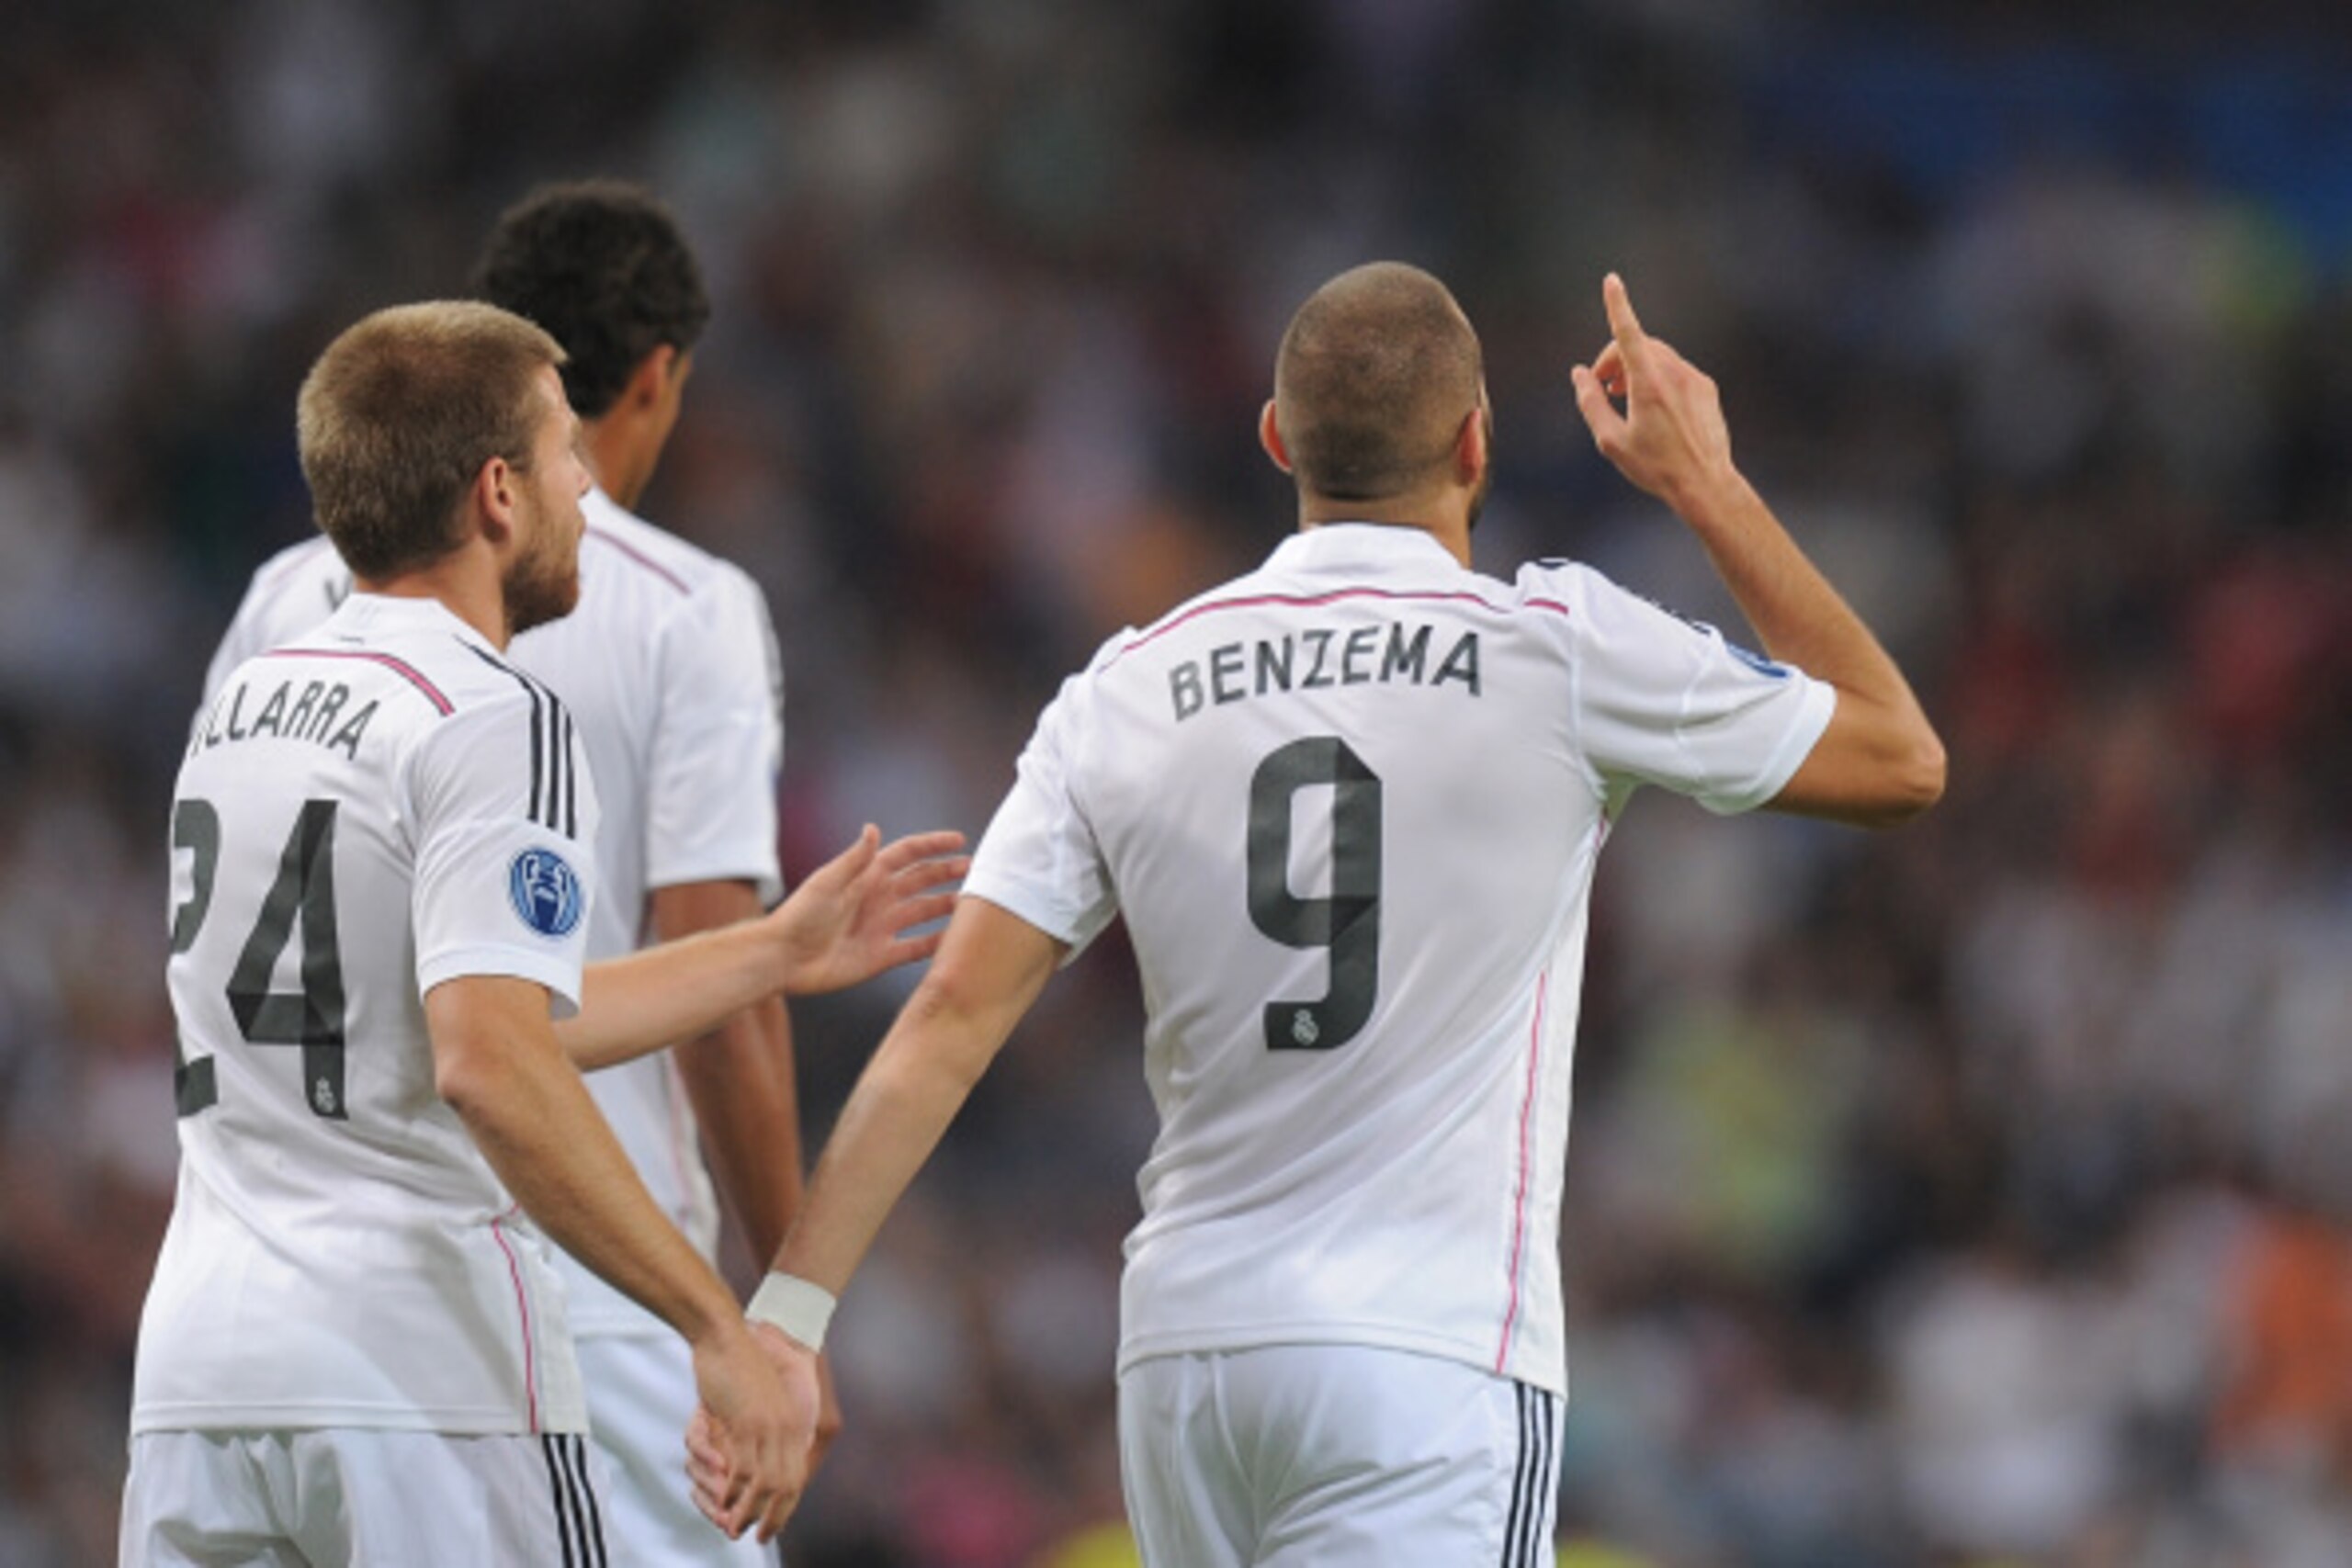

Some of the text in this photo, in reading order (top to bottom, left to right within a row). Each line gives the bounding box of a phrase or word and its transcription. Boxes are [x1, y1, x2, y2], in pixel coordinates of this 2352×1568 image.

[1170, 622, 1482, 721] BENZEMA
[171, 799, 348, 1120] 24
[1247, 736, 1382, 1051] 9
